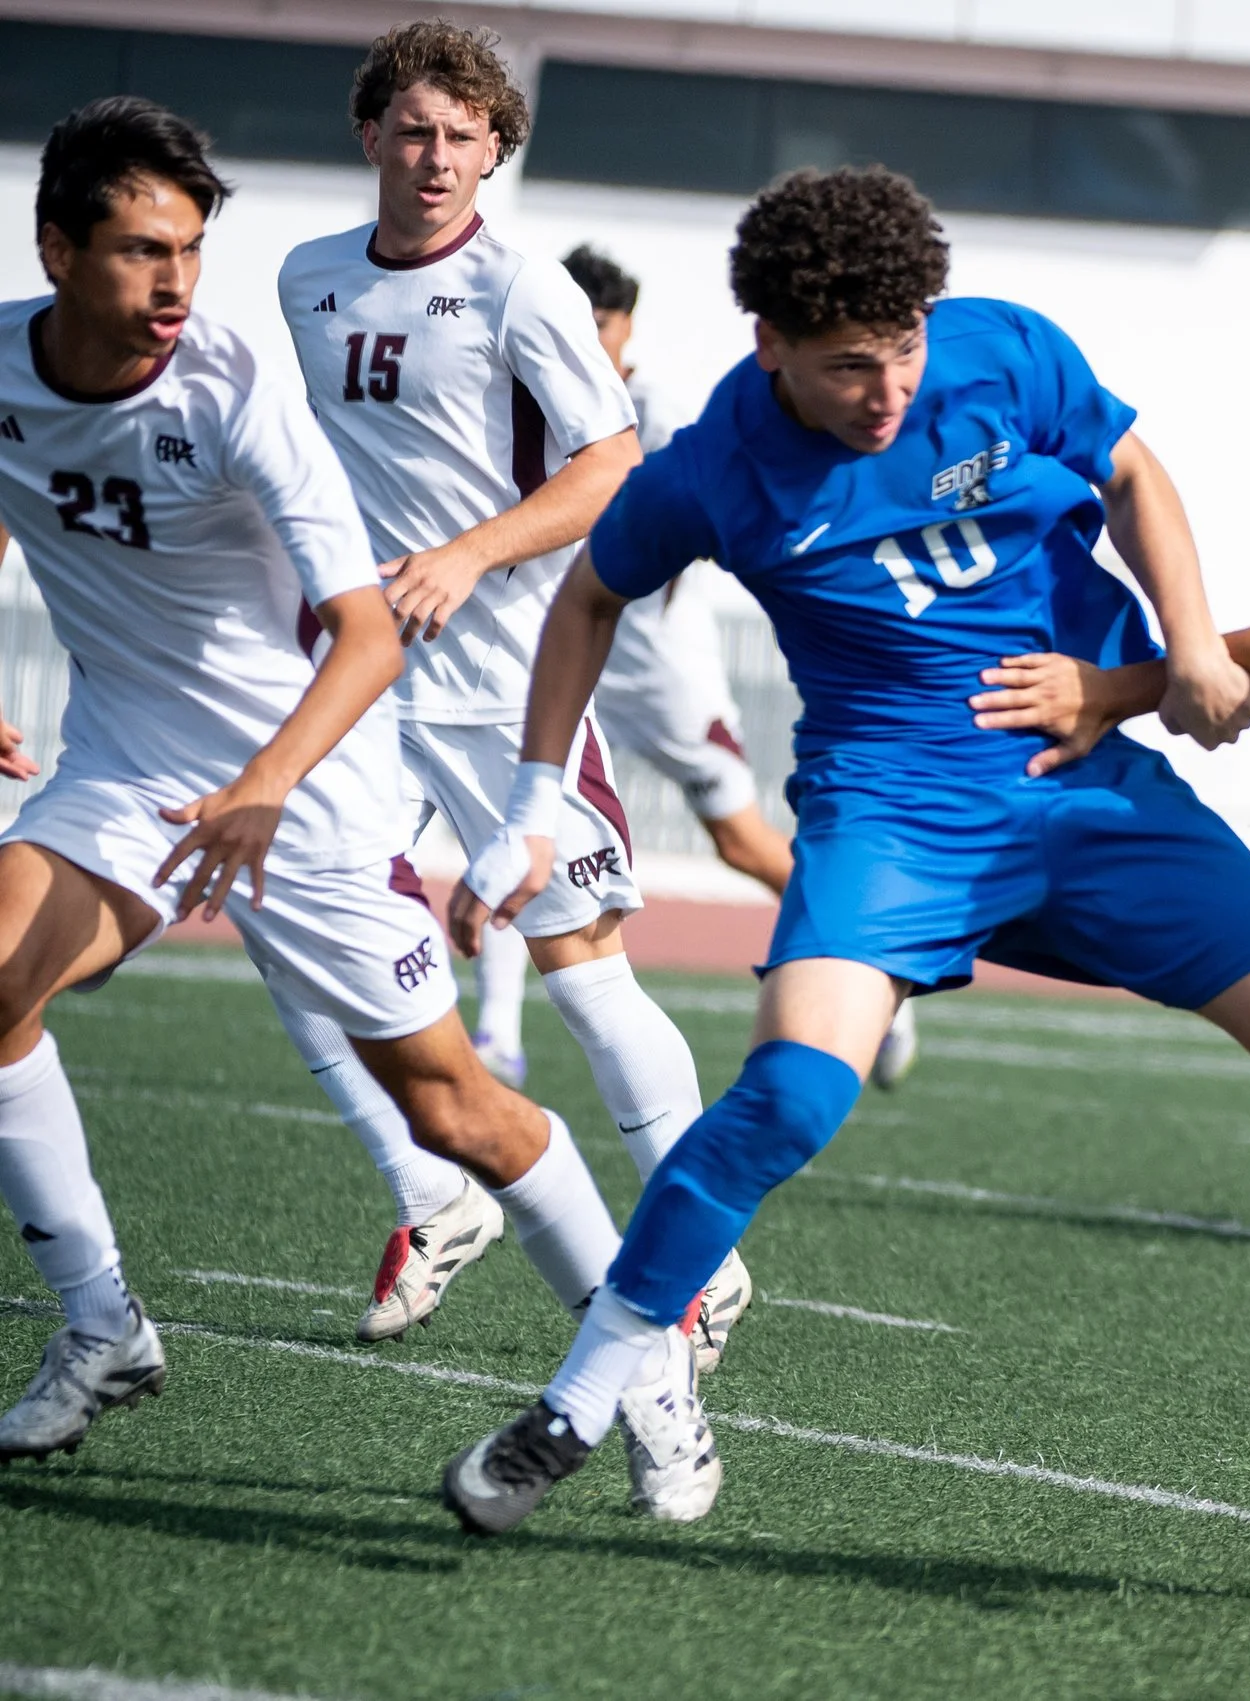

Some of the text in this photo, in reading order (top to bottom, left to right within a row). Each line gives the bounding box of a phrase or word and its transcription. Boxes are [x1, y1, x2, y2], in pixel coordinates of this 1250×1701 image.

[343, 332, 408, 403] 15
[49, 470, 150, 549] 23
[873, 518, 997, 618] 10
